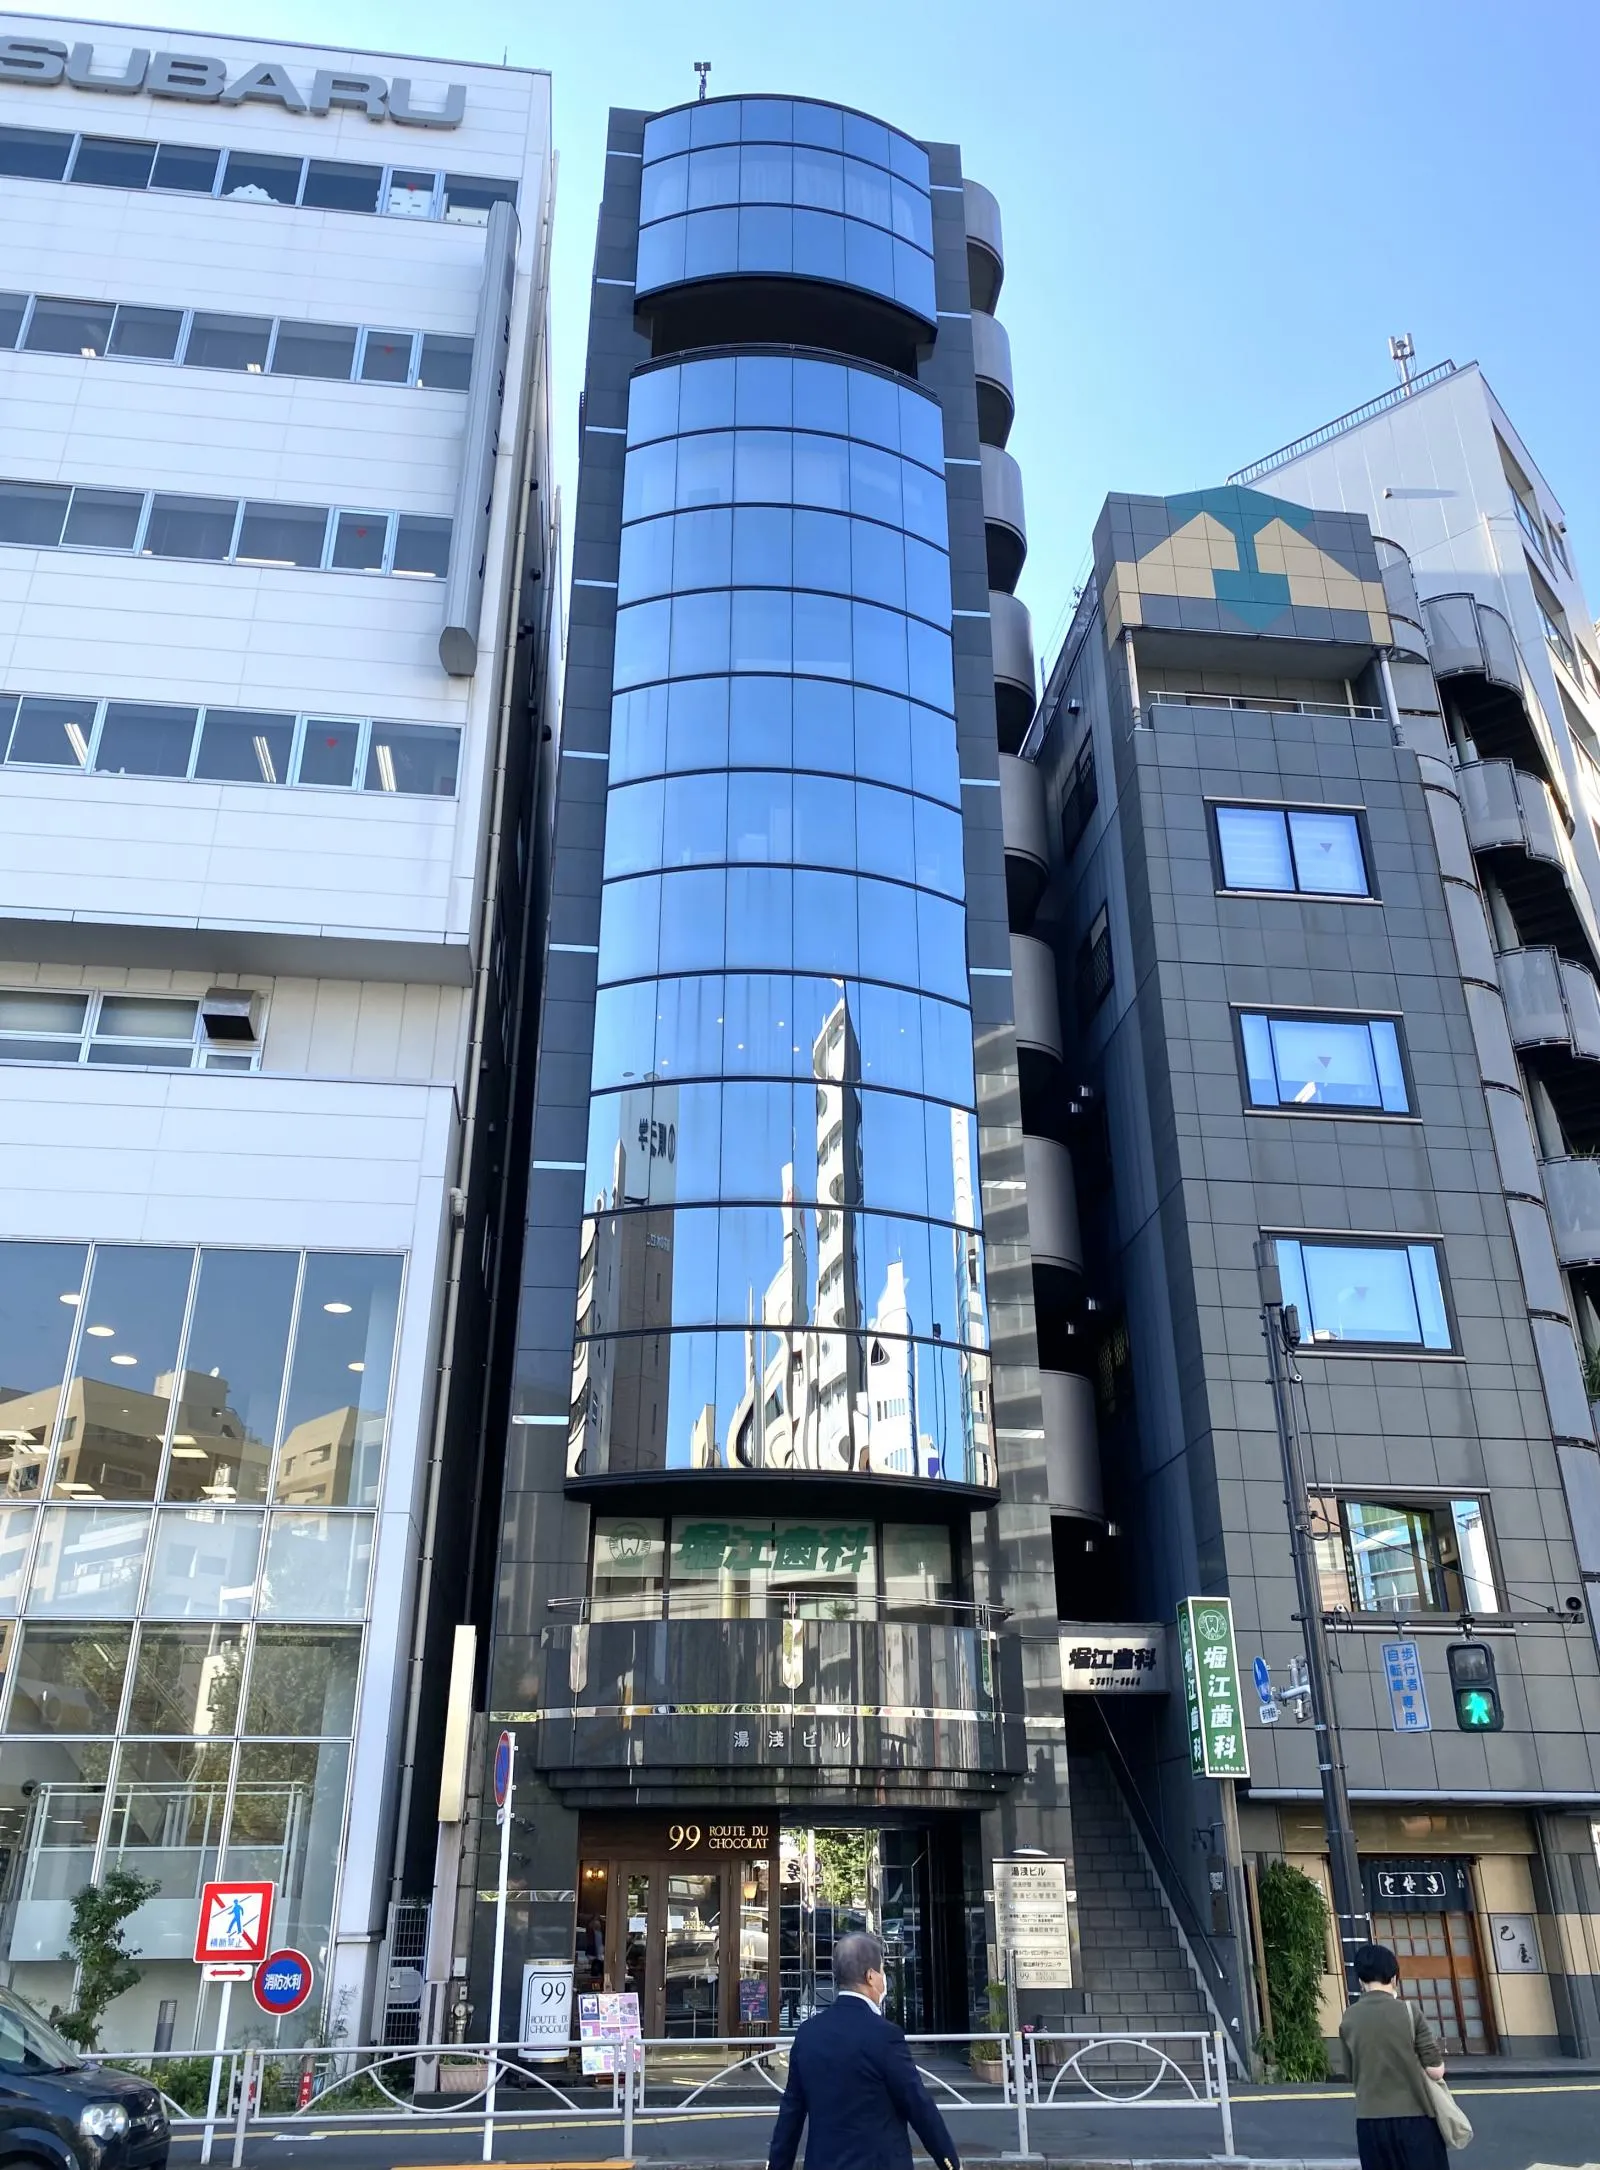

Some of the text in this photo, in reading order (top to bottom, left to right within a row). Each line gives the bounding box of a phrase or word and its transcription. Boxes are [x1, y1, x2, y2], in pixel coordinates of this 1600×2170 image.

[0, 35, 468, 131] SUBARU
[676, 1522, 869, 1573] 堀江歯科
[1068, 1646, 1157, 1671] 堀江歯科
[1387, 1649, 1404, 1691] 自転車
[1400, 1647, 1418, 1691] 歩行者
[1203, 1645, 1237, 1760] 堀江歯科
[1402, 1695, 1418, 1725] 専用
[733, 1730, 851, 1748] 湯浅ビル
[668, 1824, 769, 1851] 99 ROUTE DU
[708, 1837, 769, 1849] CHOCOLAT
[1011, 1866, 1046, 1876] 湯浅ビル
[264, 1973, 303, 1991] 消防水利
[540, 1981, 566, 2005] 99
[530, 2015, 557, 2024] ROUTE
